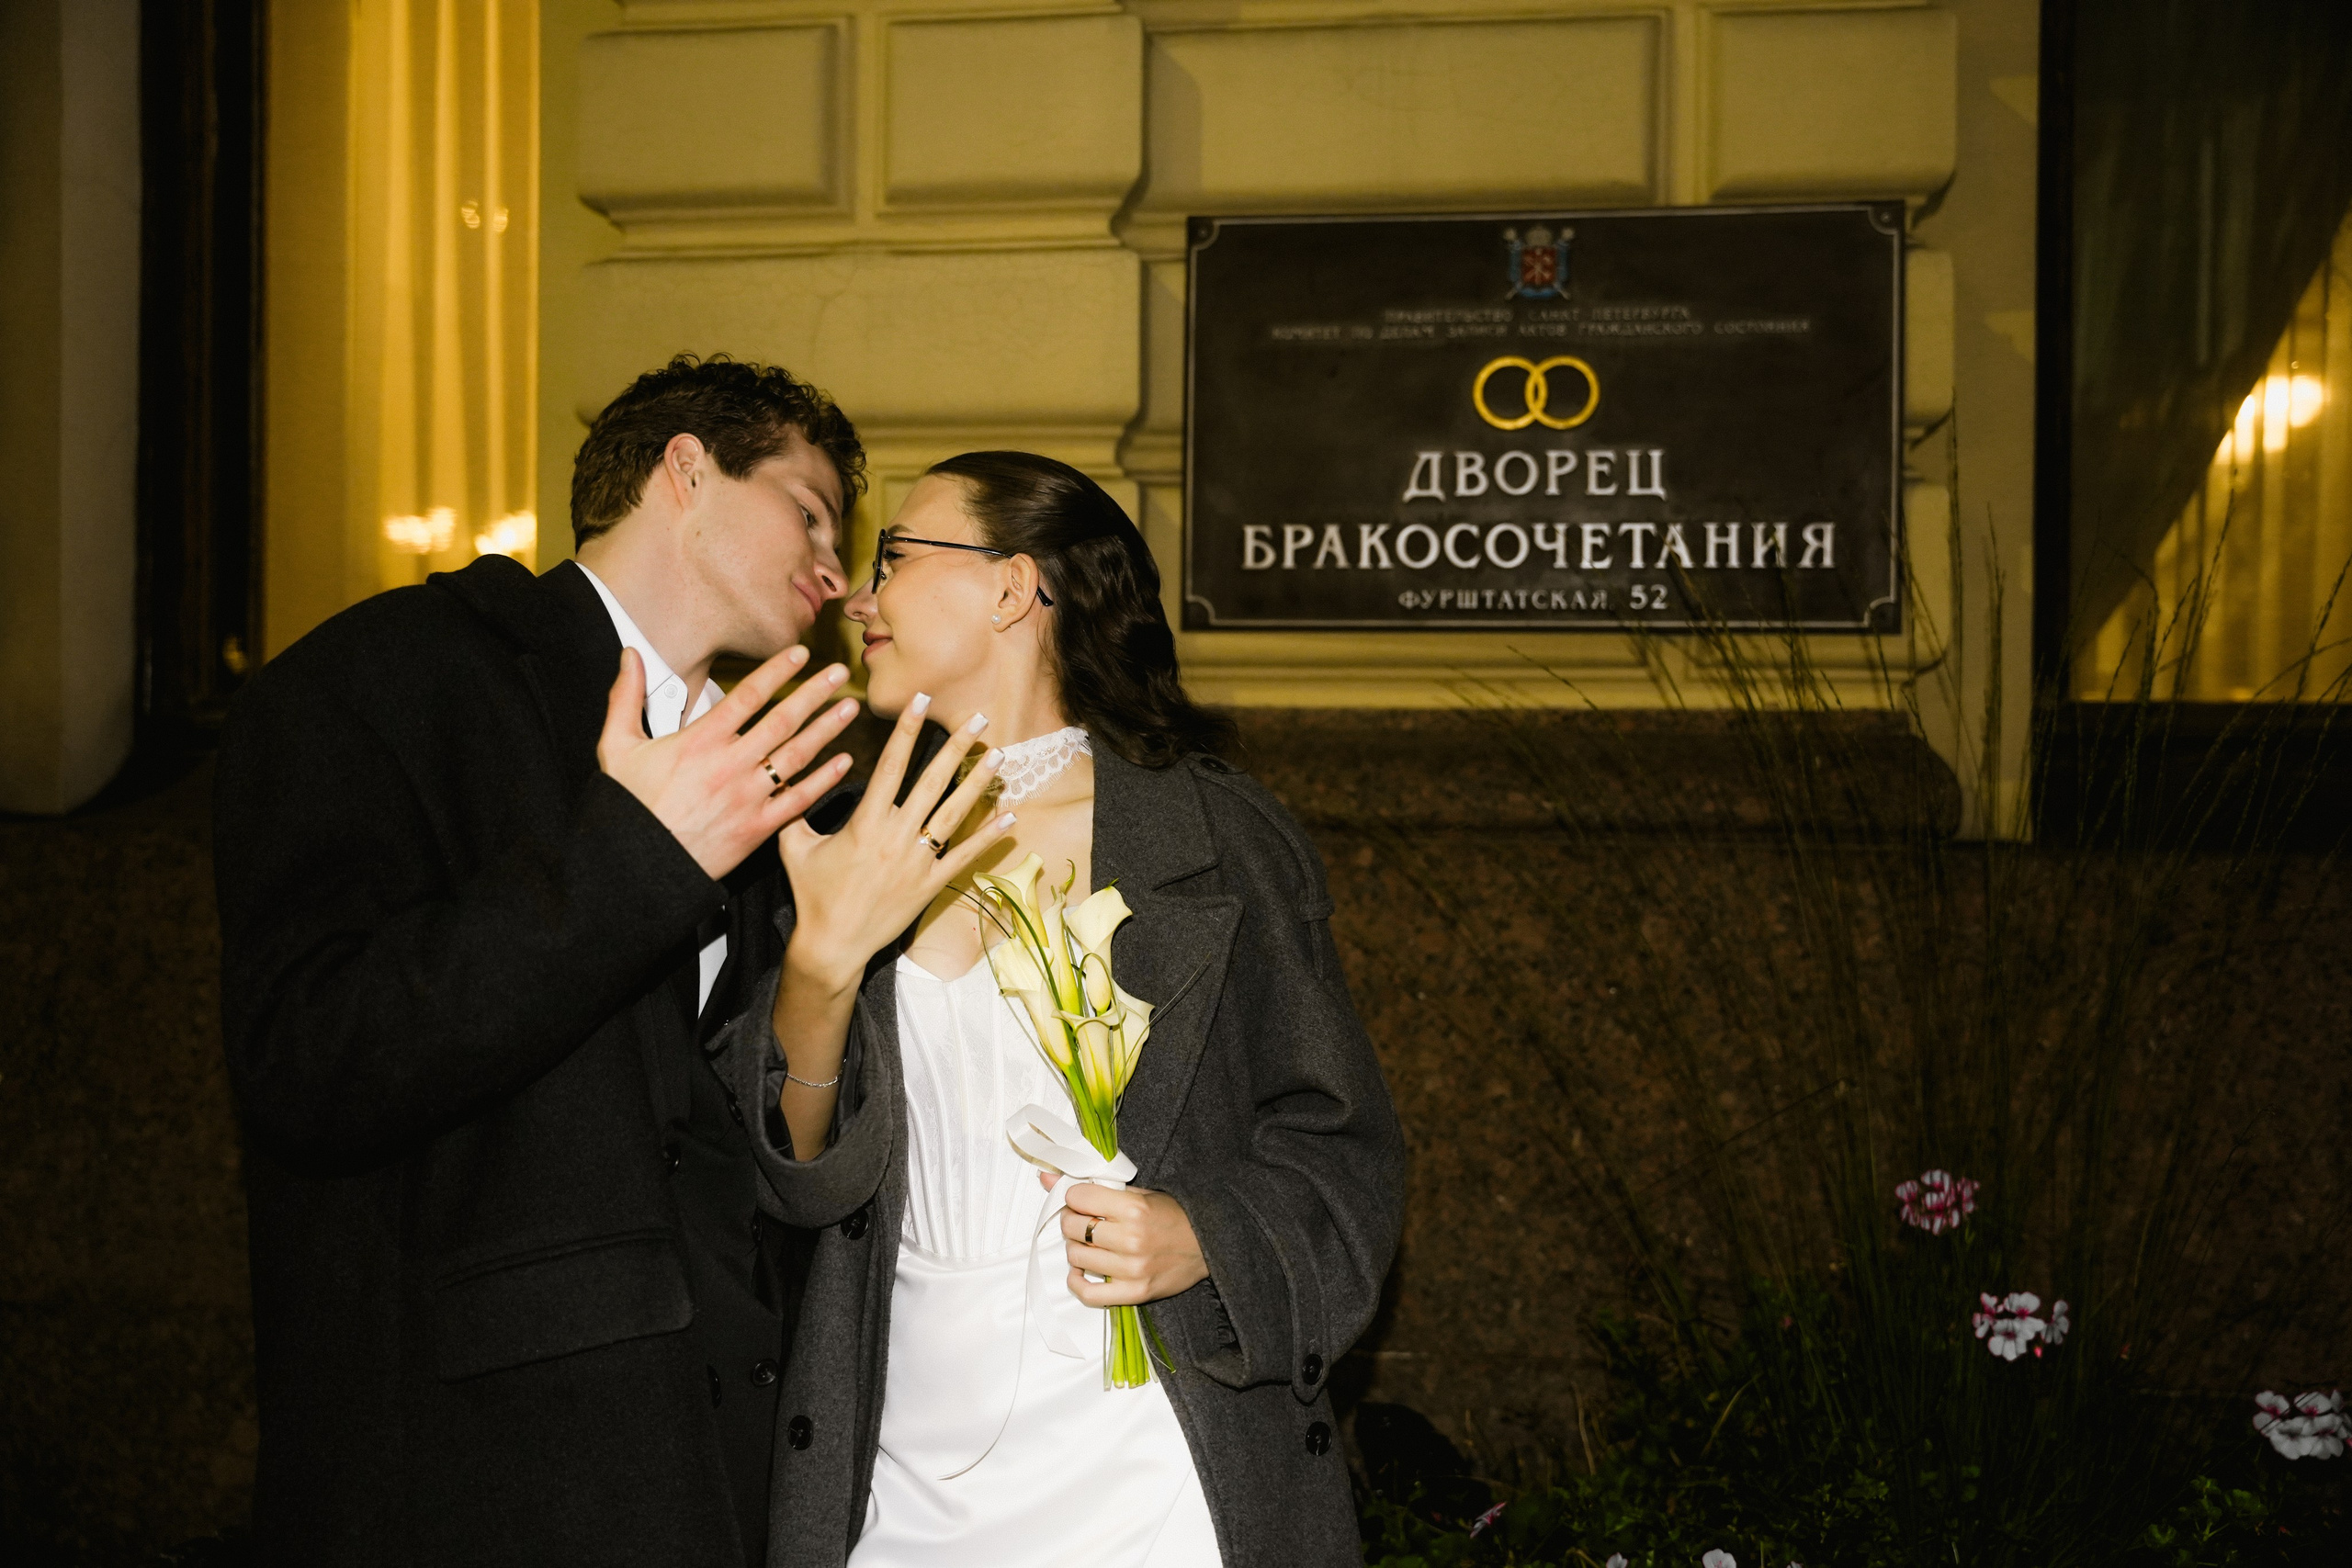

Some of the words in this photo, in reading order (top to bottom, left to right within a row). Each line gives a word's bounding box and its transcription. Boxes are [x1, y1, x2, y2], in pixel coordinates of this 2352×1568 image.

[1402, 448, 1668, 502] ДВОРЕЦ
[1240, 521, 1837, 570] БРАКОСОЧЕТАНИЯ
[1628, 583, 1669, 611] 52
